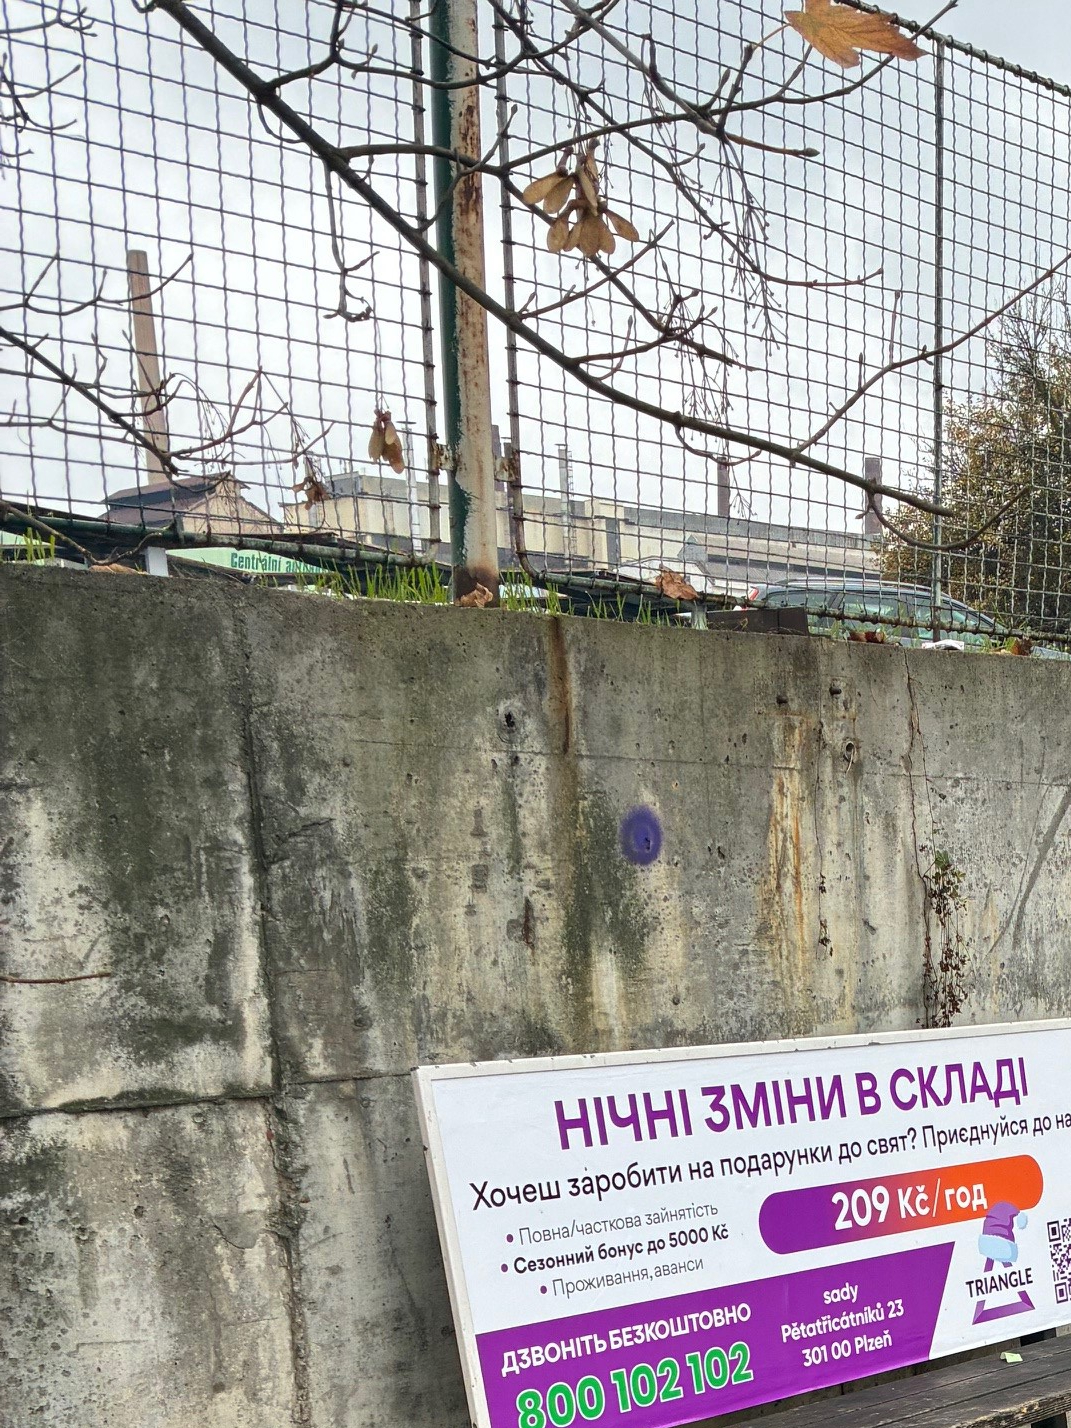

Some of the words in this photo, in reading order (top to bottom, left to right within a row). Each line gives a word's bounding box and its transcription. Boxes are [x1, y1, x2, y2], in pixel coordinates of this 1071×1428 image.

[554, 1089, 693, 1150] НІЧНІ
[700, 1074, 847, 1133] ЗМІНИ
[855, 1071, 882, 1116] В
[889, 1057, 1029, 1111] СКЛАДІ
[469, 1179, 561, 1211] Хочеш
[567, 1162, 683, 1201] заробити
[688, 1160, 715, 1181] на
[719, 1144, 833, 1177] подарунки
[838, 1143, 863, 1164] до
[867, 1127, 917, 1156] свят?
[922, 1115, 1029, 1153] Приєднуйся
[1033, 1115, 1052, 1137] до
[518, 1213, 642, 1246] Повна/часткова
[644, 1202, 719, 1227] зайнятість
[831, 1185, 890, 1231] 209
[513, 1245, 595, 1274] Сезонний
[597, 1240, 643, 1261] бонус
[647, 1236, 666, 1255] до
[668, 1226, 709, 1249] 5000
[823, 1282, 859, 1304] sady
[965, 1267, 1034, 1298] TRIANGLE
[501, 1333, 608, 1378] ДЗВОНІТЬ
[608, 1302, 752, 1350] БЕЗКОШТОВНО
[781, 1303, 886, 1343] Pětatřicátníků
[887, 1298, 905, 1318] 23
[802, 1346, 828, 1367] 301
[831, 1340, 852, 1361] 00
[854, 1330, 893, 1355] Plzeň
[610, 1356, 684, 1414] 102
[686, 1341, 755, 1396] 102
